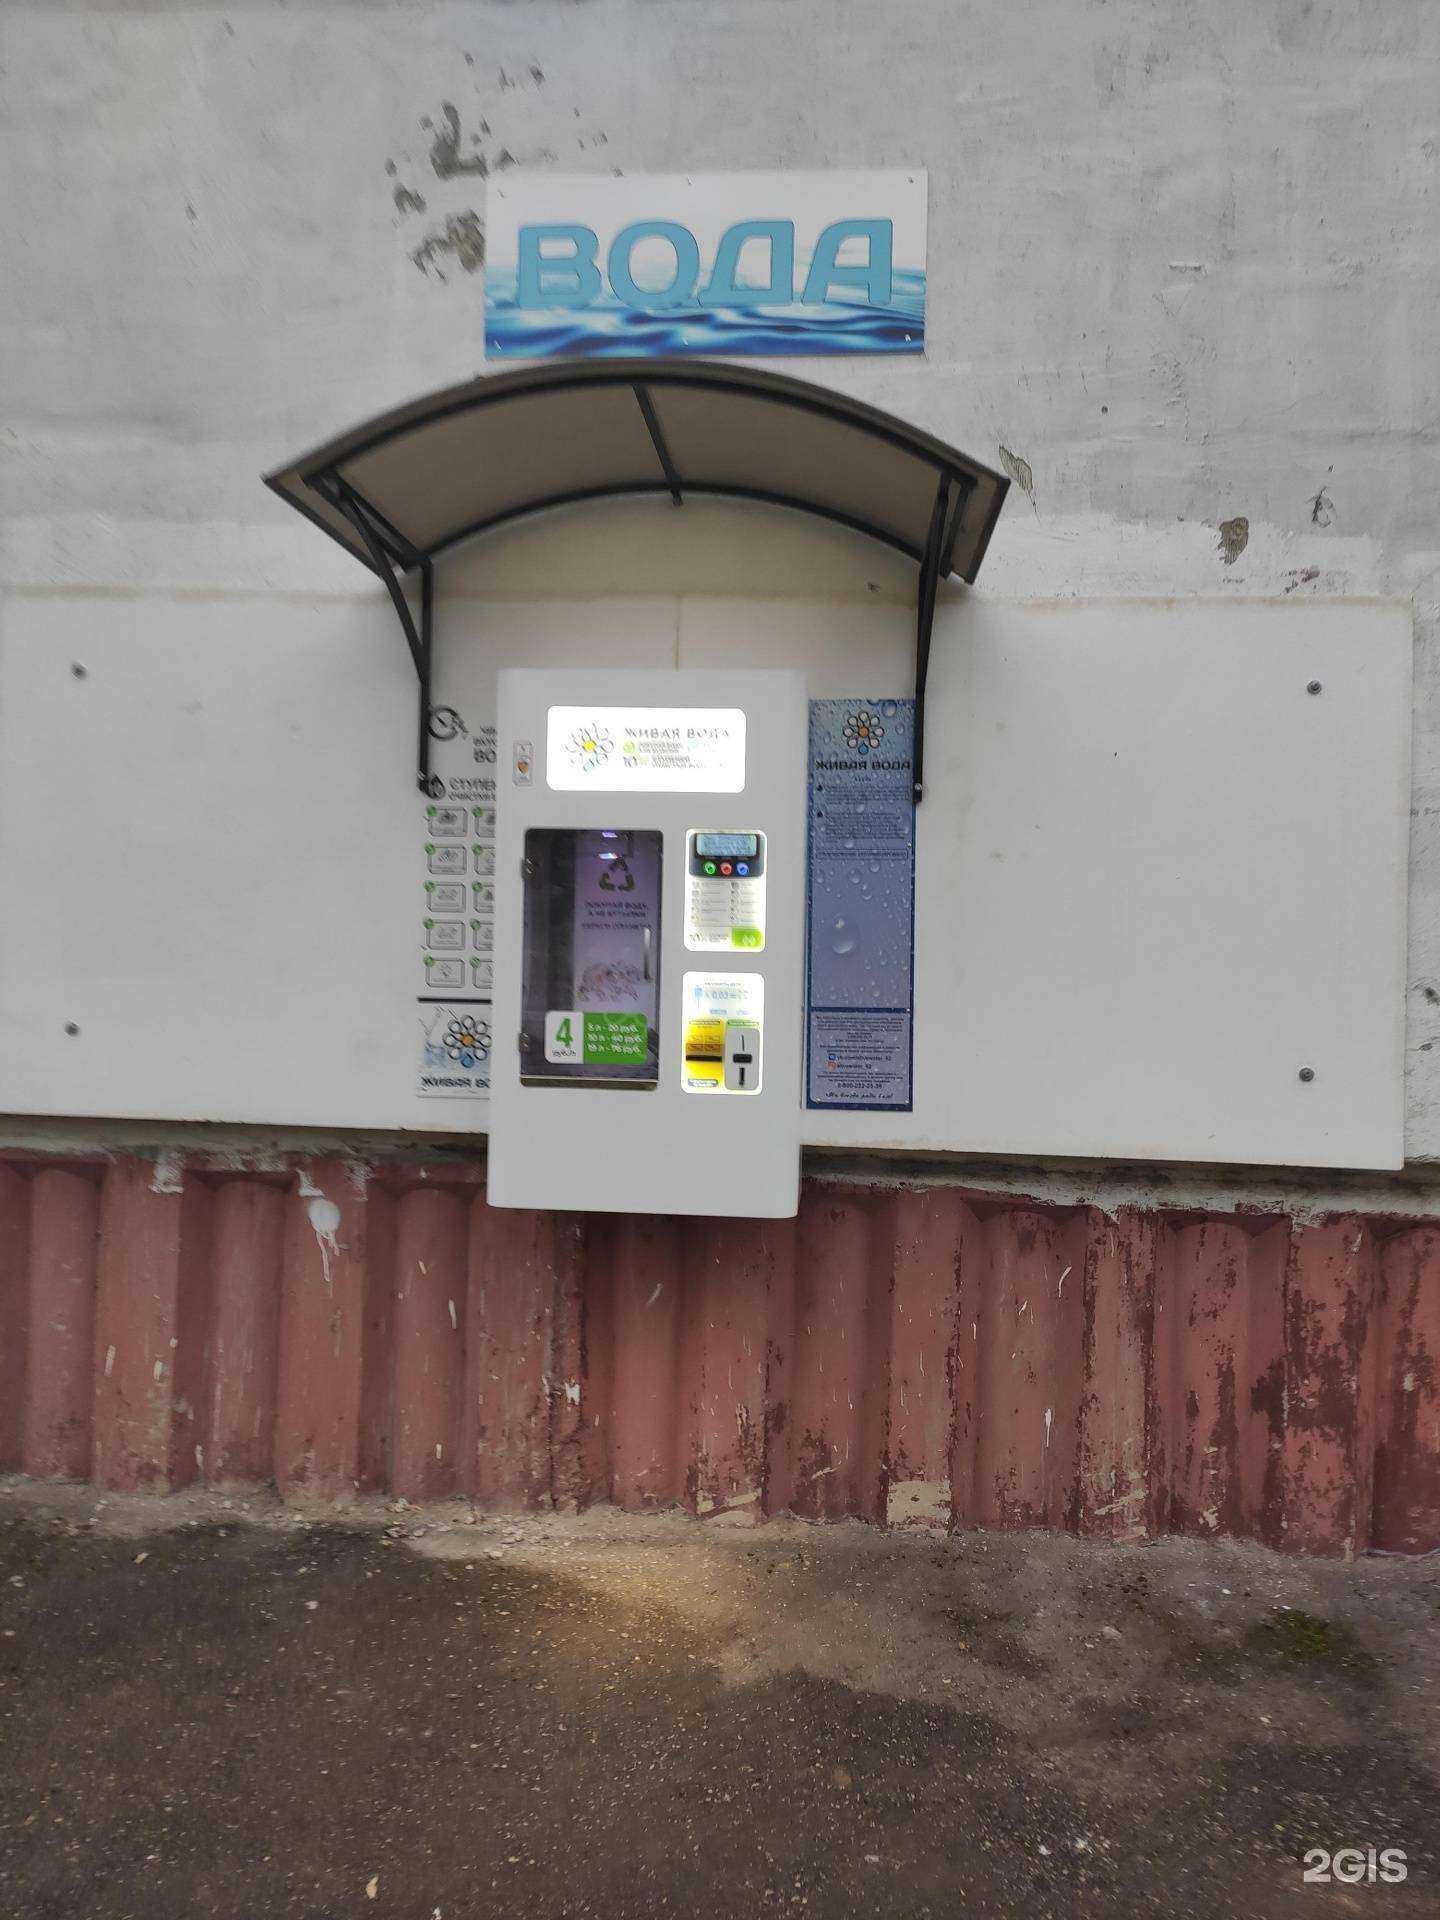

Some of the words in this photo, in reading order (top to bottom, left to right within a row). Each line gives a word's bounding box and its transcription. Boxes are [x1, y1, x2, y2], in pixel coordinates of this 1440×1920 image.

[518, 218, 893, 307] ВОДА
[816, 760, 867, 770] ЖИВАЯ
[872, 760, 910, 770] ВОДА
[556, 1018, 574, 1047] 4
